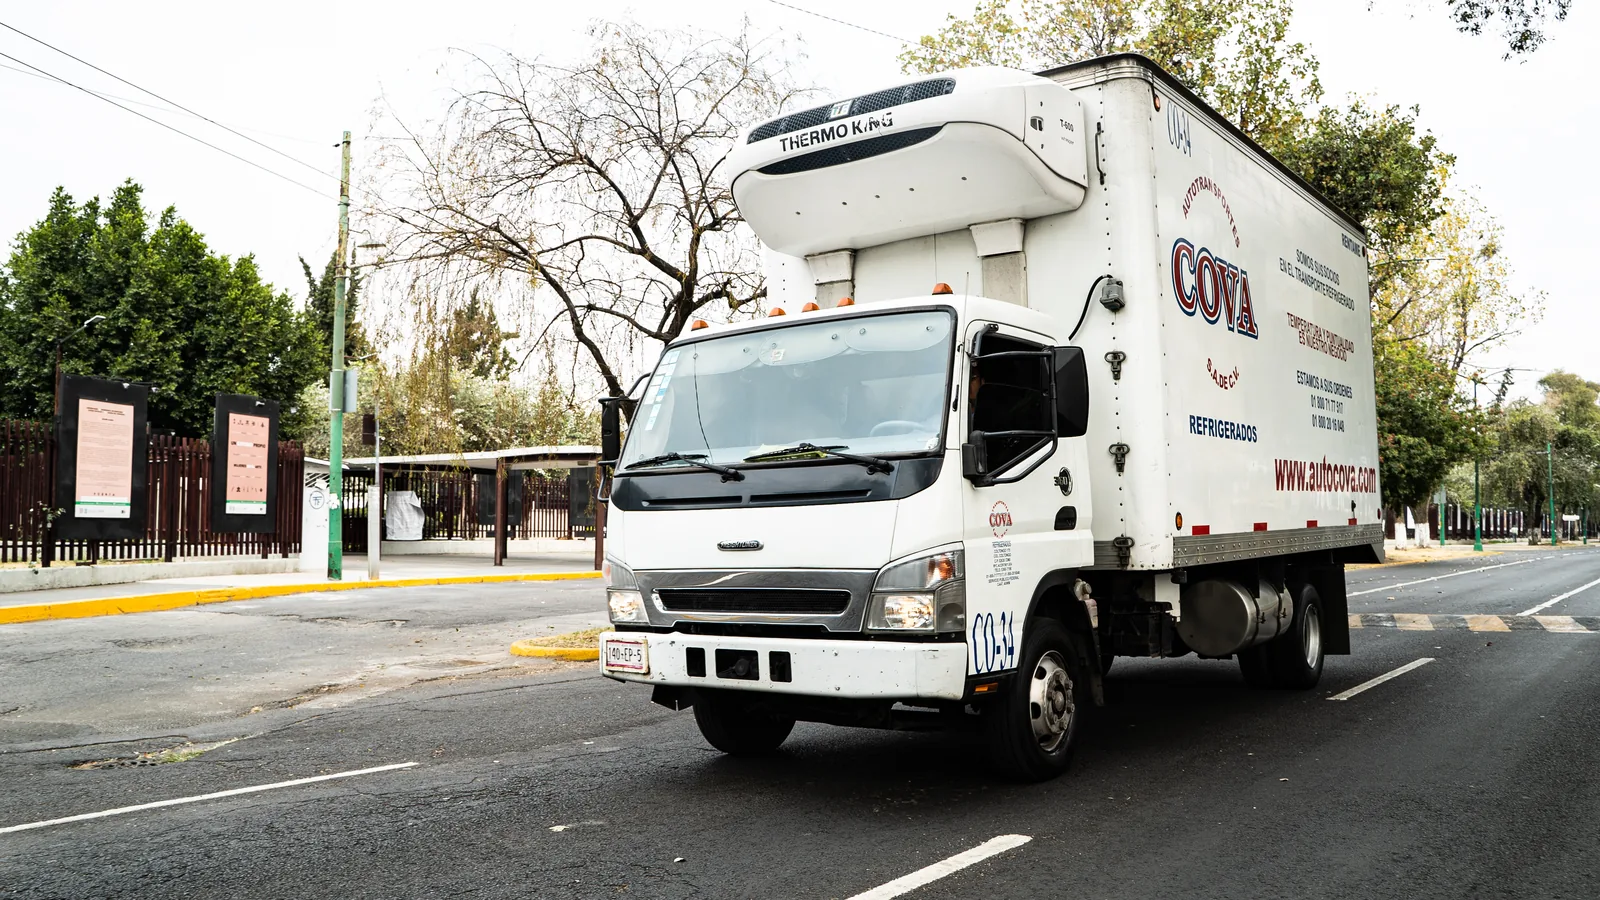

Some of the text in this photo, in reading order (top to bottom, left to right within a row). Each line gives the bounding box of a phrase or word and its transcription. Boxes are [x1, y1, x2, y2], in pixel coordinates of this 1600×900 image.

[780, 123, 848, 152] THERMO
[1167, 100, 1191, 157] CO-34
[1279, 257, 1355, 311] EN EL TRANSPORTE REFRIGERADO
[1296, 249, 1340, 286] SOMOS SUS SOCIOS
[1172, 238, 1258, 339] COVA
[1287, 312, 1322, 339] TEMPERATURA
[1326, 330, 1355, 354] PUNTUALIDAD
[1299, 331, 1306, 345] ES
[1306, 333, 1328, 354] NUESTRO
[1297, 370, 1319, 390] ESTAMOS
[1324, 379, 1333, 394] SUS
[1333, 382, 1353, 399] ORDENES
[1189, 415, 1258, 443] REFRIGERADOS
[1275, 454, 1376, 493] www.autocova.com
[989, 512, 1013, 528] COVA
[972, 610, 1015, 674] CO-34
